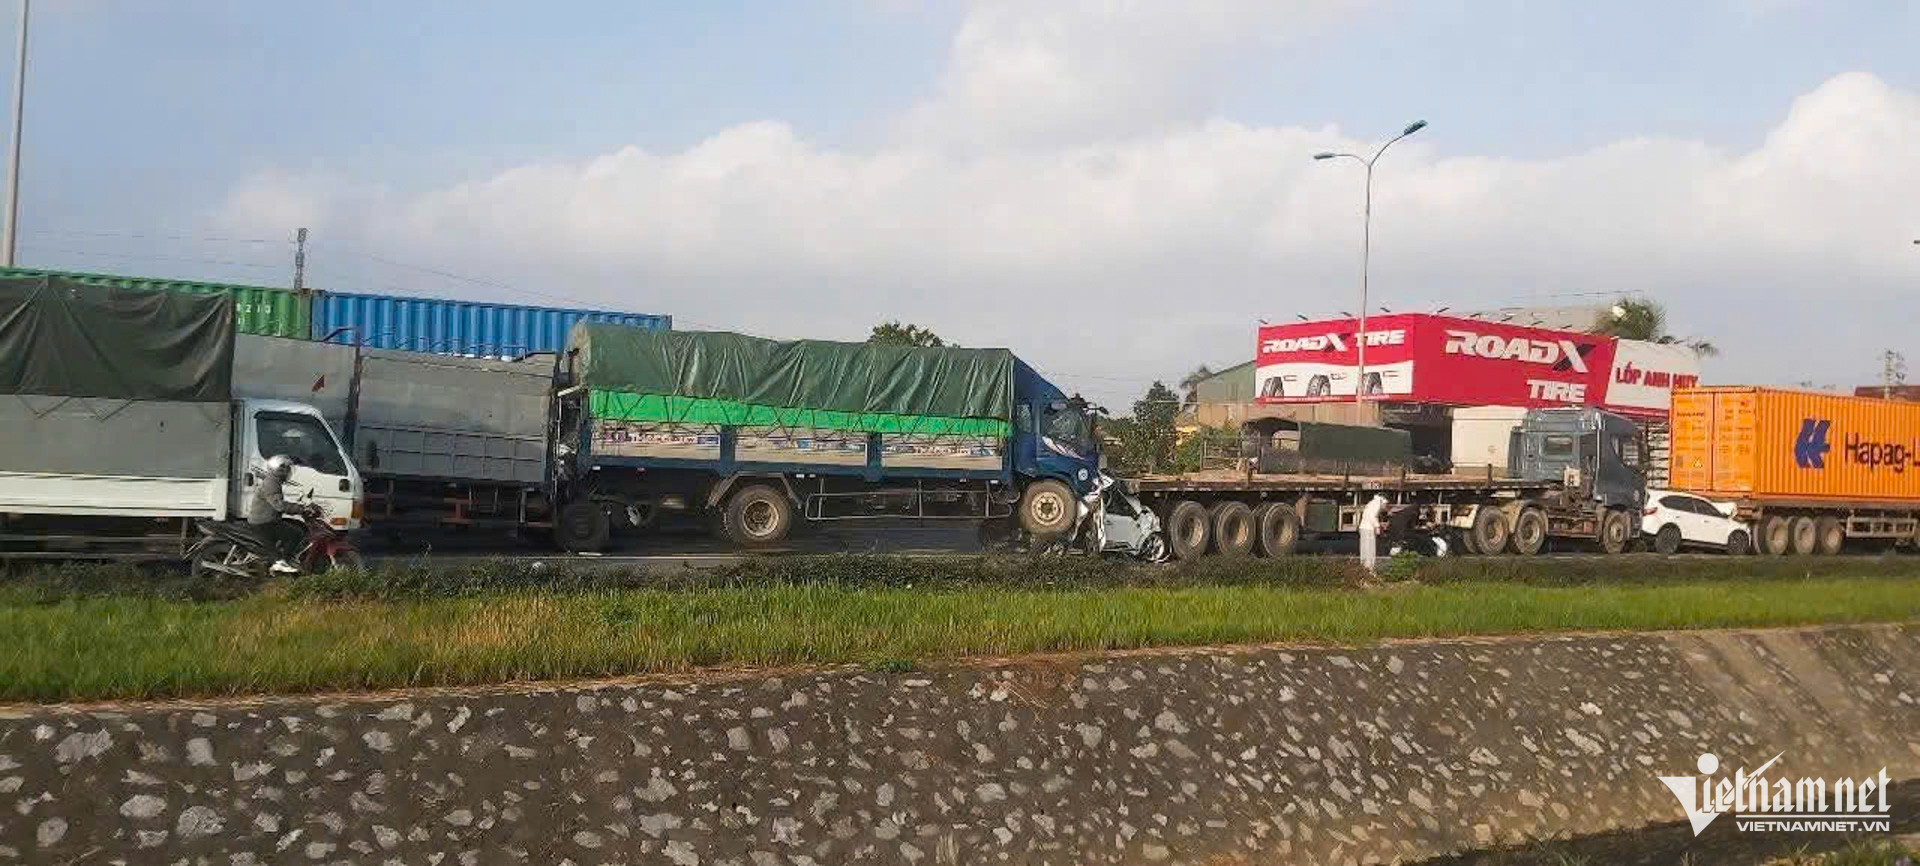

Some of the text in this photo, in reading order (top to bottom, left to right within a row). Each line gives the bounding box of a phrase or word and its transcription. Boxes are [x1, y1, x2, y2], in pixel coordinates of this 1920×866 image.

[1262, 329, 1406, 353] ROADX TIRE
[1445, 329, 1597, 373] ROADX
[1526, 379, 1588, 403] TIRE
[1644, 370, 1670, 388] ANH
